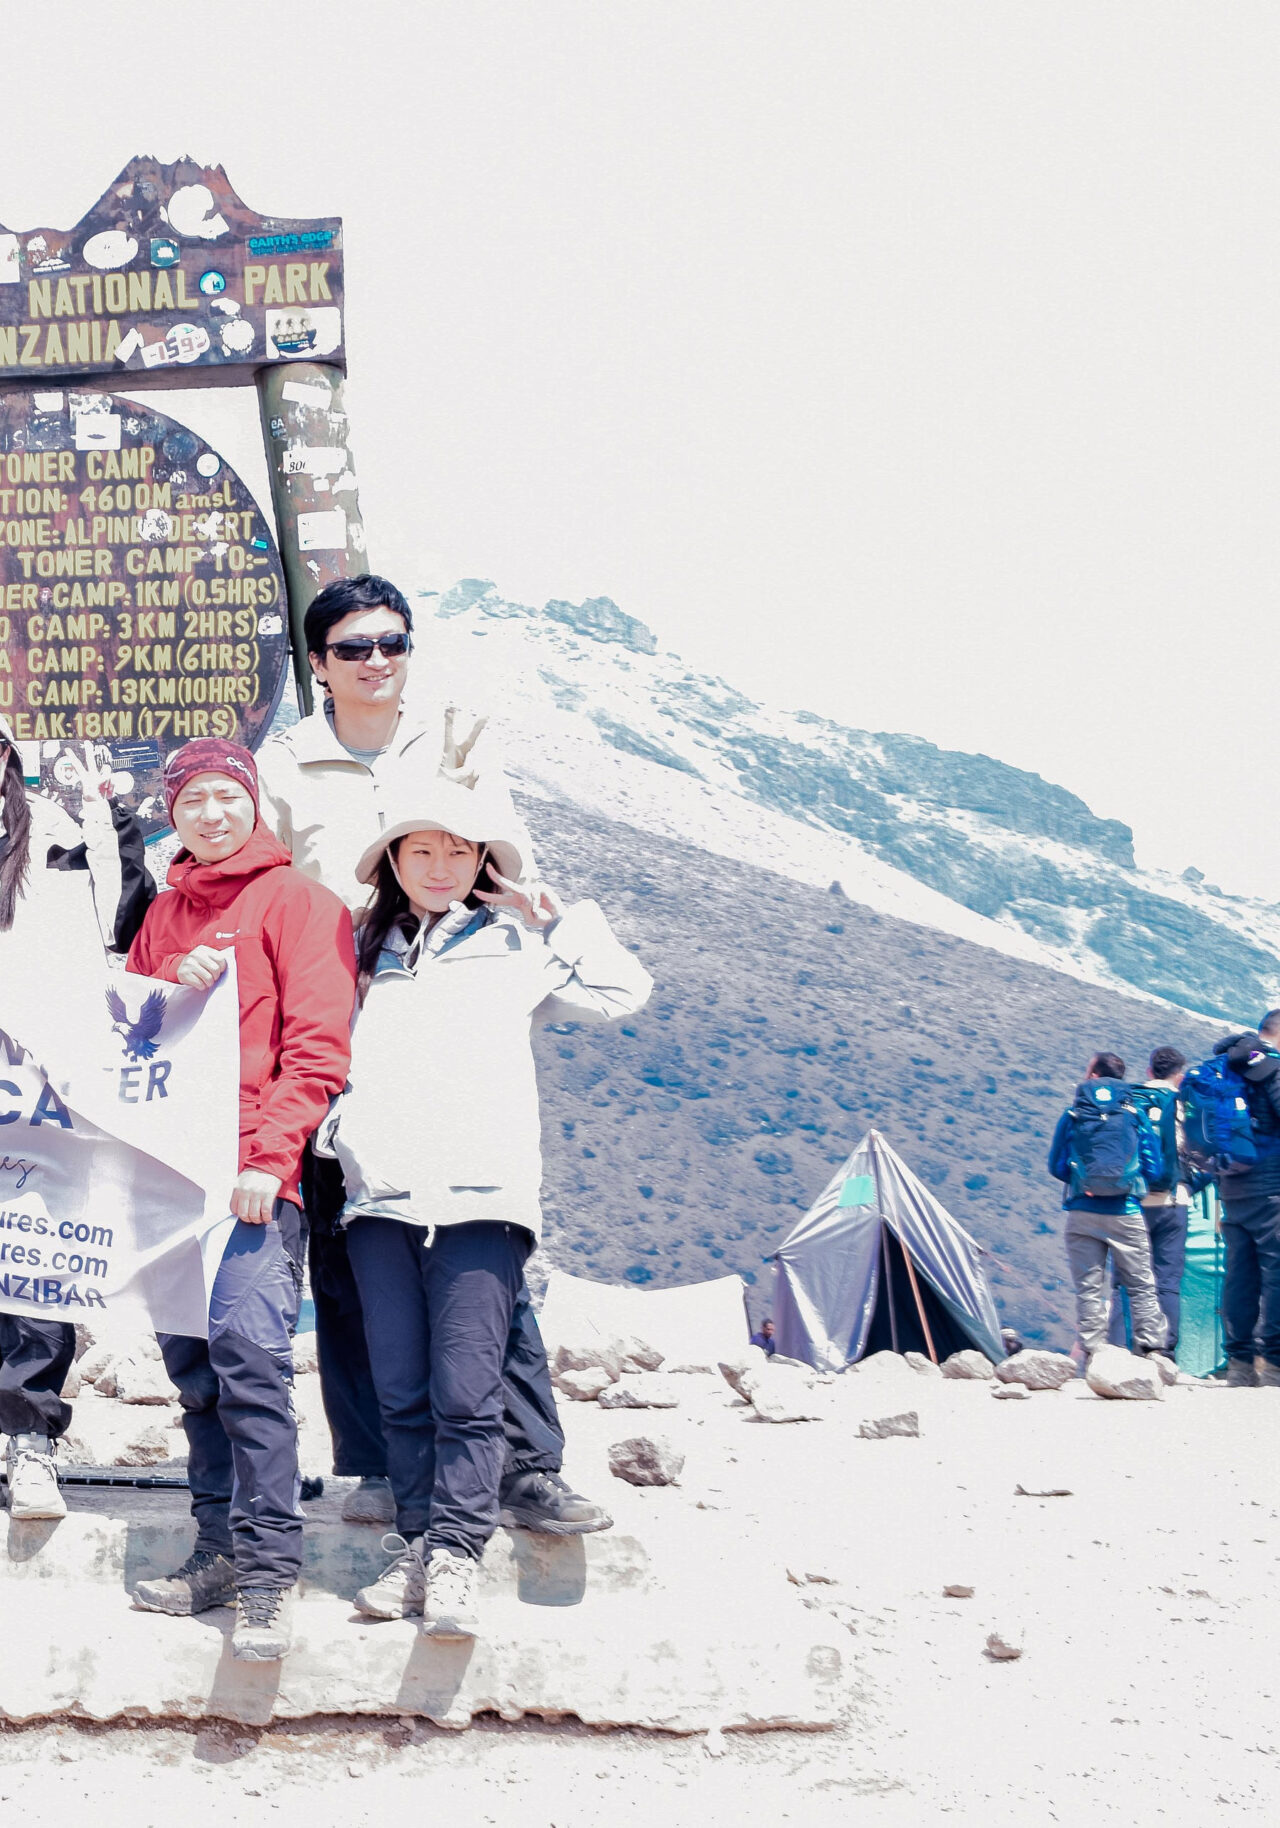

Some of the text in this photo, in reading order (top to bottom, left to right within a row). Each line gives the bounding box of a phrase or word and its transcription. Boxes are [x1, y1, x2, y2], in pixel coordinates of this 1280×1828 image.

[28, 269, 199, 319] NATIONAL
[244, 262, 332, 305] PARK
[87, 447, 155, 481] CAMP
[79, 482, 170, 512] 4600M
[175, 480, 237, 510] amsl
[17, 549, 113, 579] TOWER
[126, 546, 203, 575] CAMP
[27, 612, 111, 641] CAMP:
[27, 646, 105, 673] CAMP:
[26, 679, 103, 706] CAMP:
